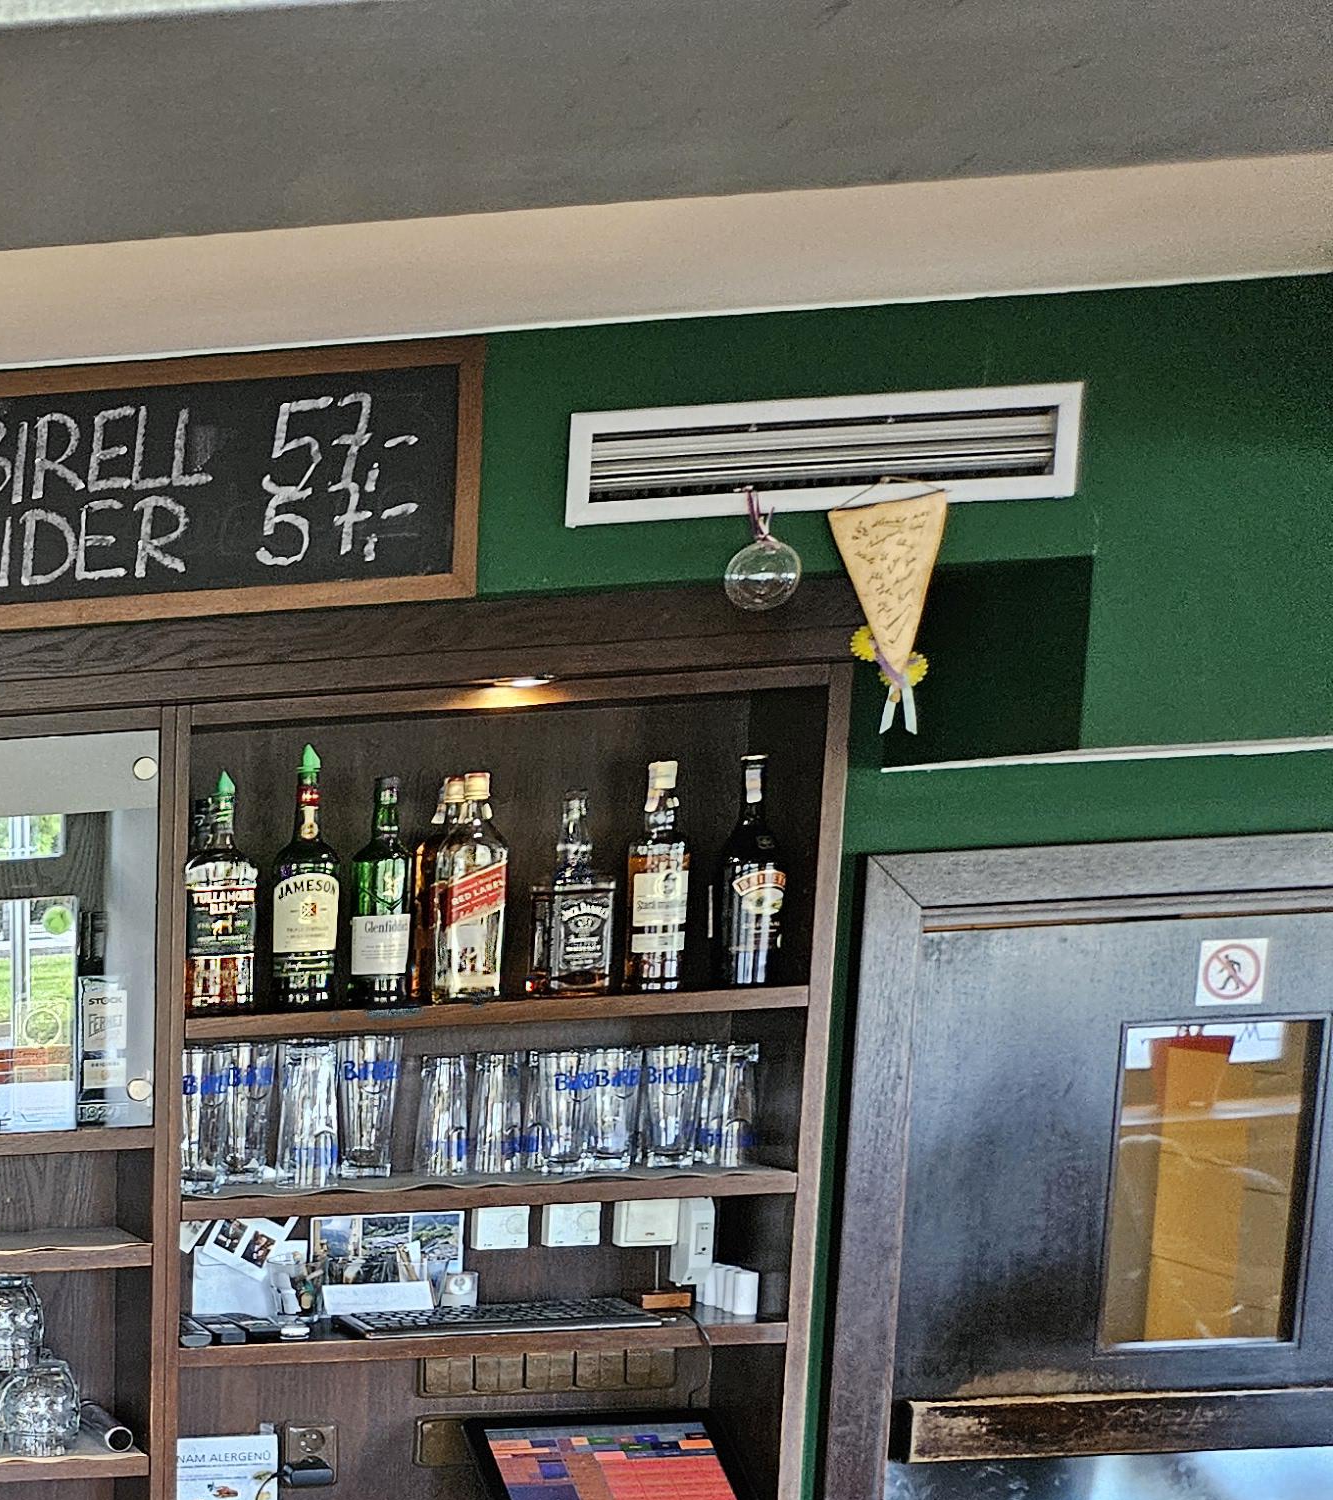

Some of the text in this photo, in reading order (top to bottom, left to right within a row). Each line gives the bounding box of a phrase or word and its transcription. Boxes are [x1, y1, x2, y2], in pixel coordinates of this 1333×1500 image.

[277, 879, 337, 900] JAMESON
[452, 879, 504, 907] RED LABEL
[88, 997, 122, 1006] STOCK
[177, 1453, 206, 1464] NAM
